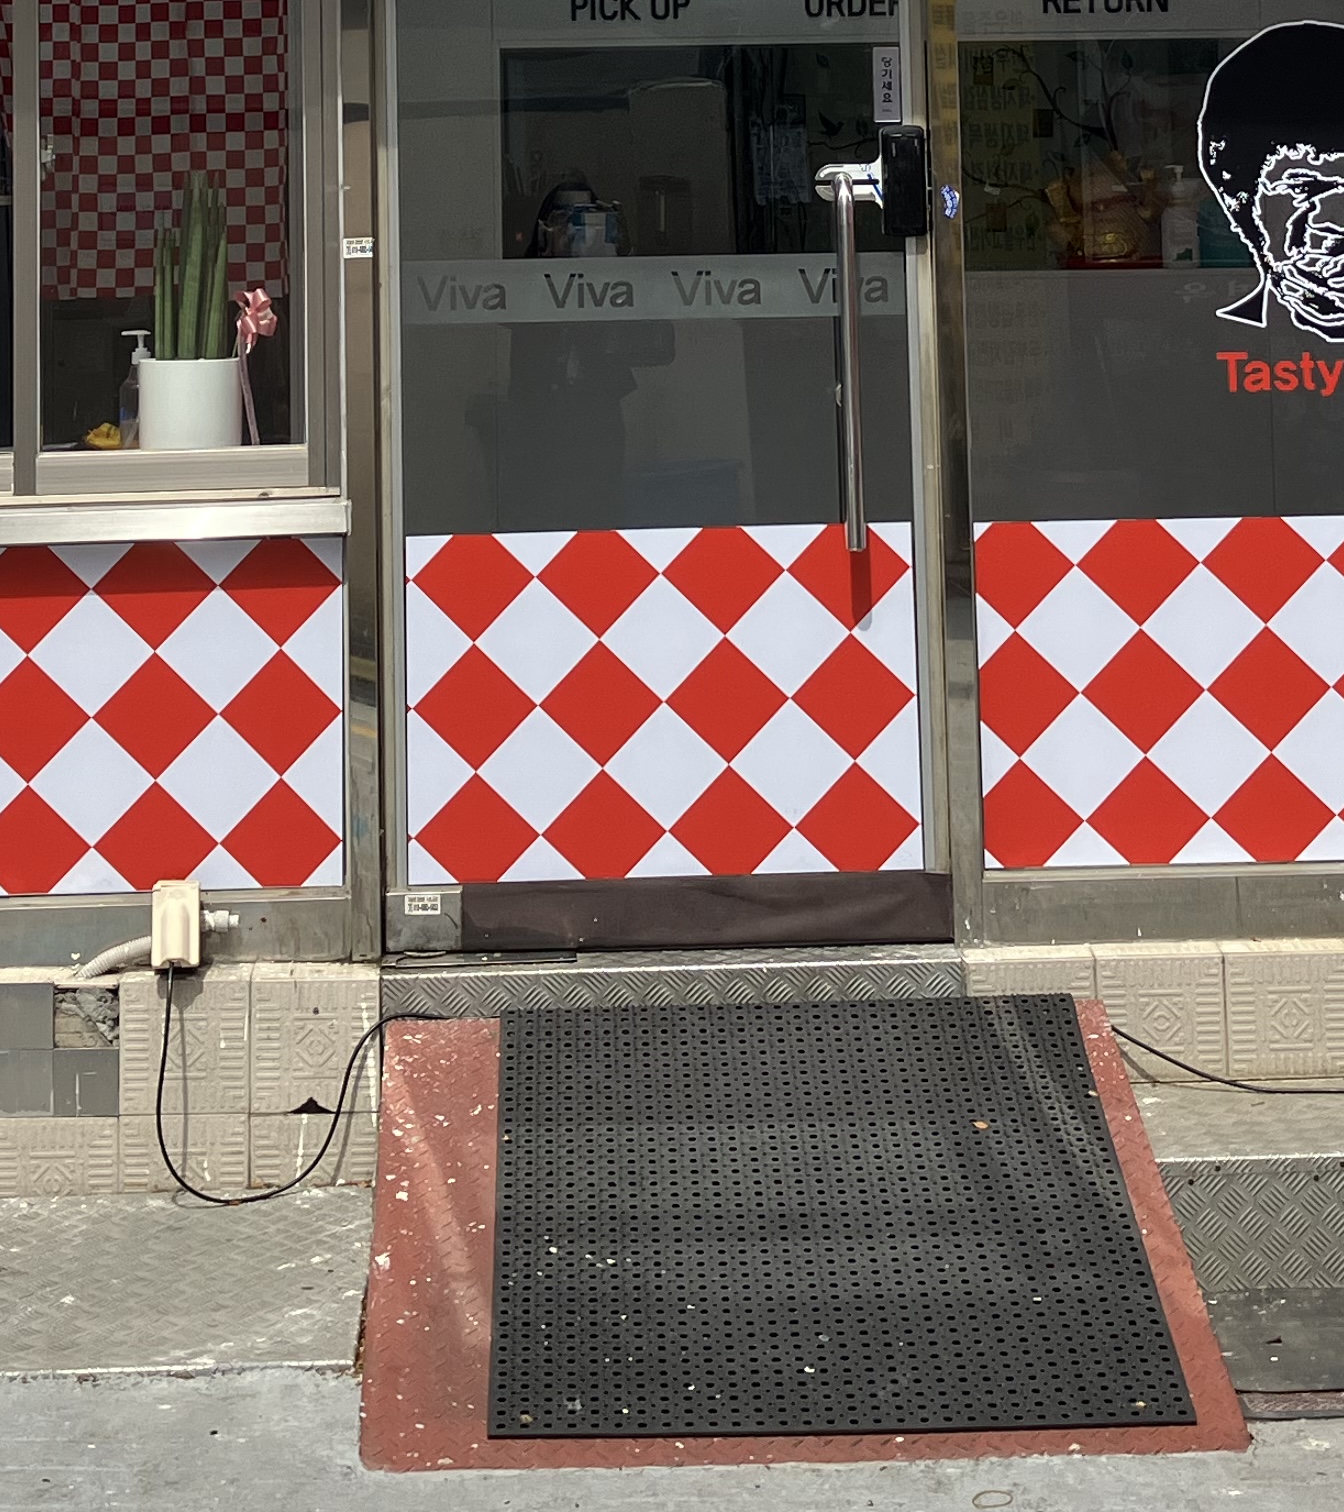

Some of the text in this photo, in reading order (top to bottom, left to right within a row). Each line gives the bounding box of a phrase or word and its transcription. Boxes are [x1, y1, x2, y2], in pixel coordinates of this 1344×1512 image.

[880, 56, 894, 104] 당기세요
[416, 266, 889, 312] Viva Viva Viva Via
[1216, 350, 1344, 396] Tasty
